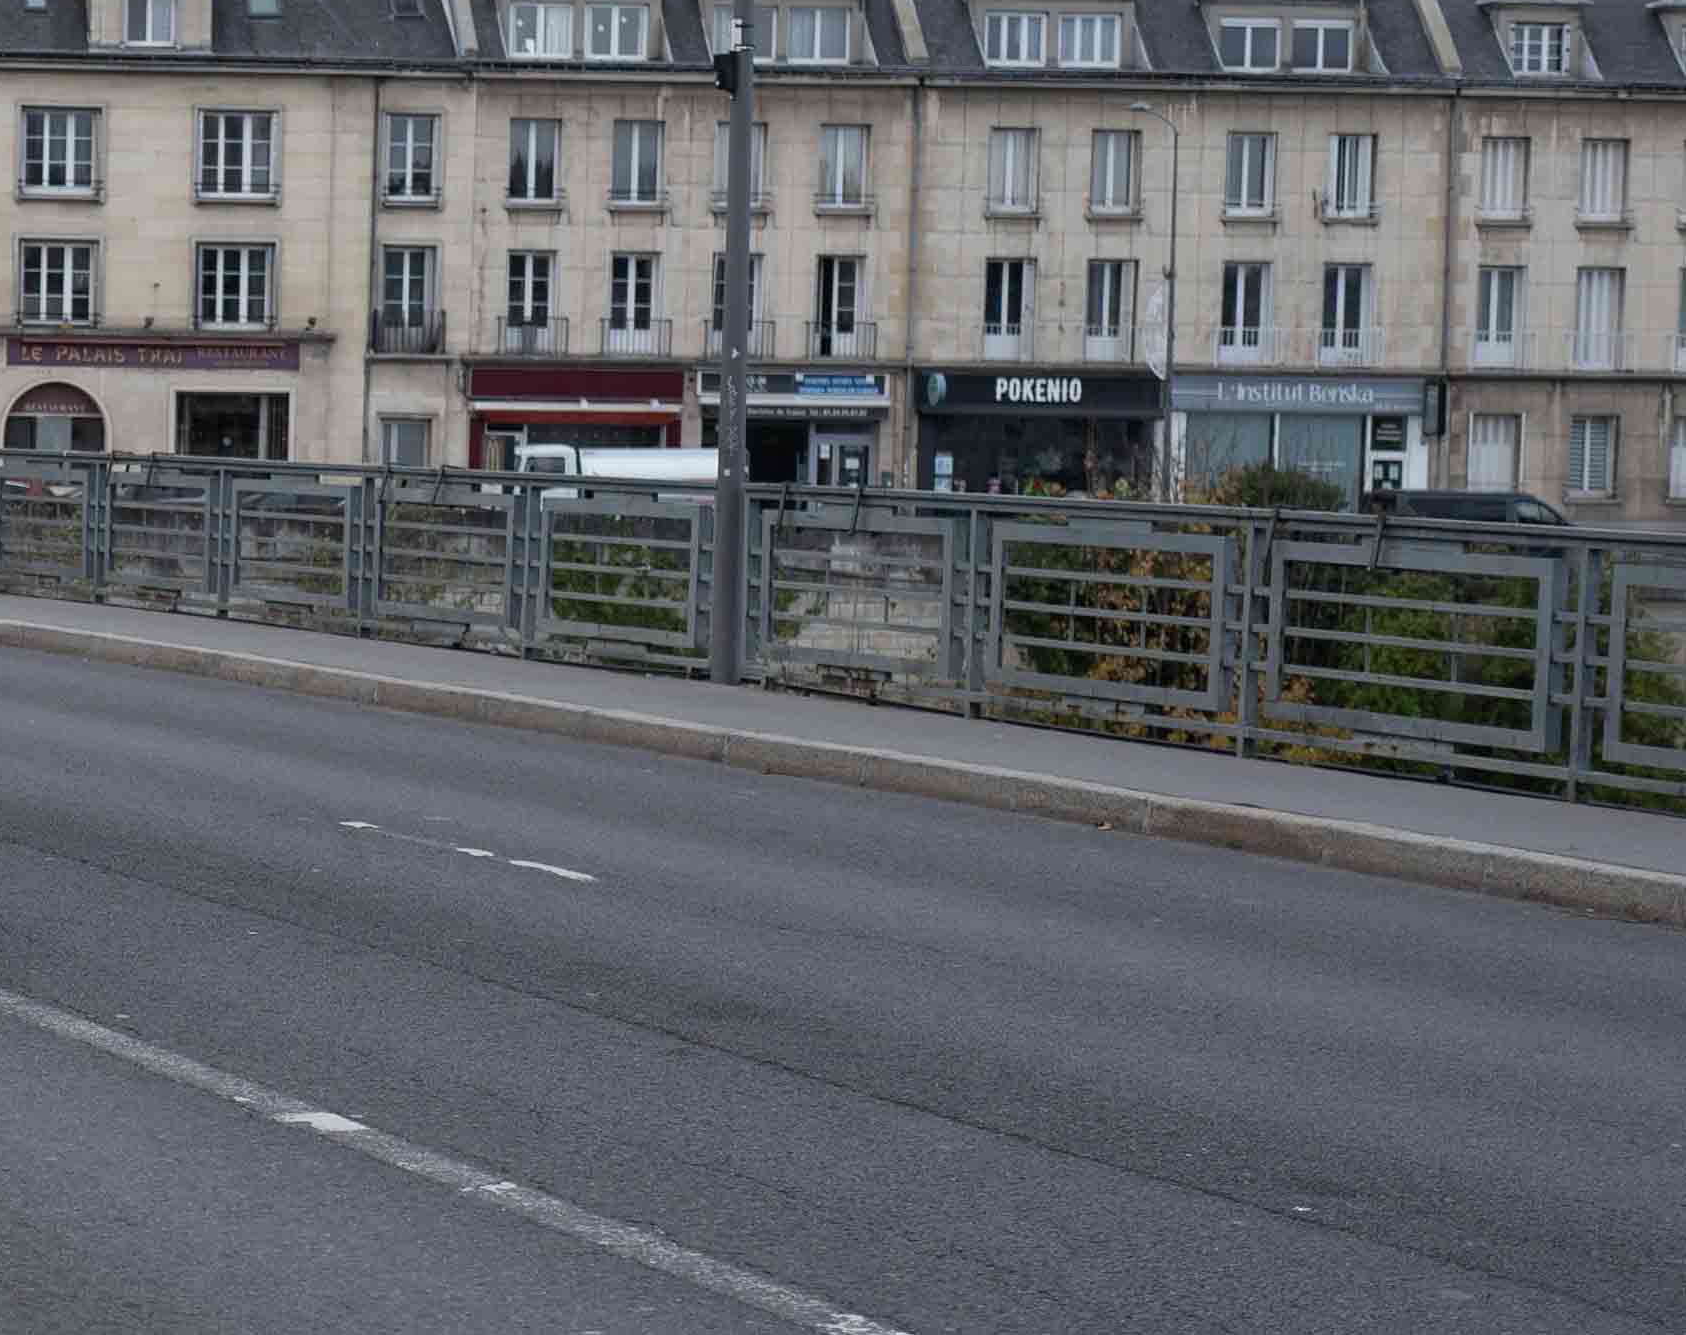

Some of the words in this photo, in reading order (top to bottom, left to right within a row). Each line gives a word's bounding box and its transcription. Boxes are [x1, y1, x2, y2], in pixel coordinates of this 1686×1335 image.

[21, 345, 43, 361] LE
[55, 345, 125, 363] PALAIS
[995, 377, 1083, 403] POKENIO
